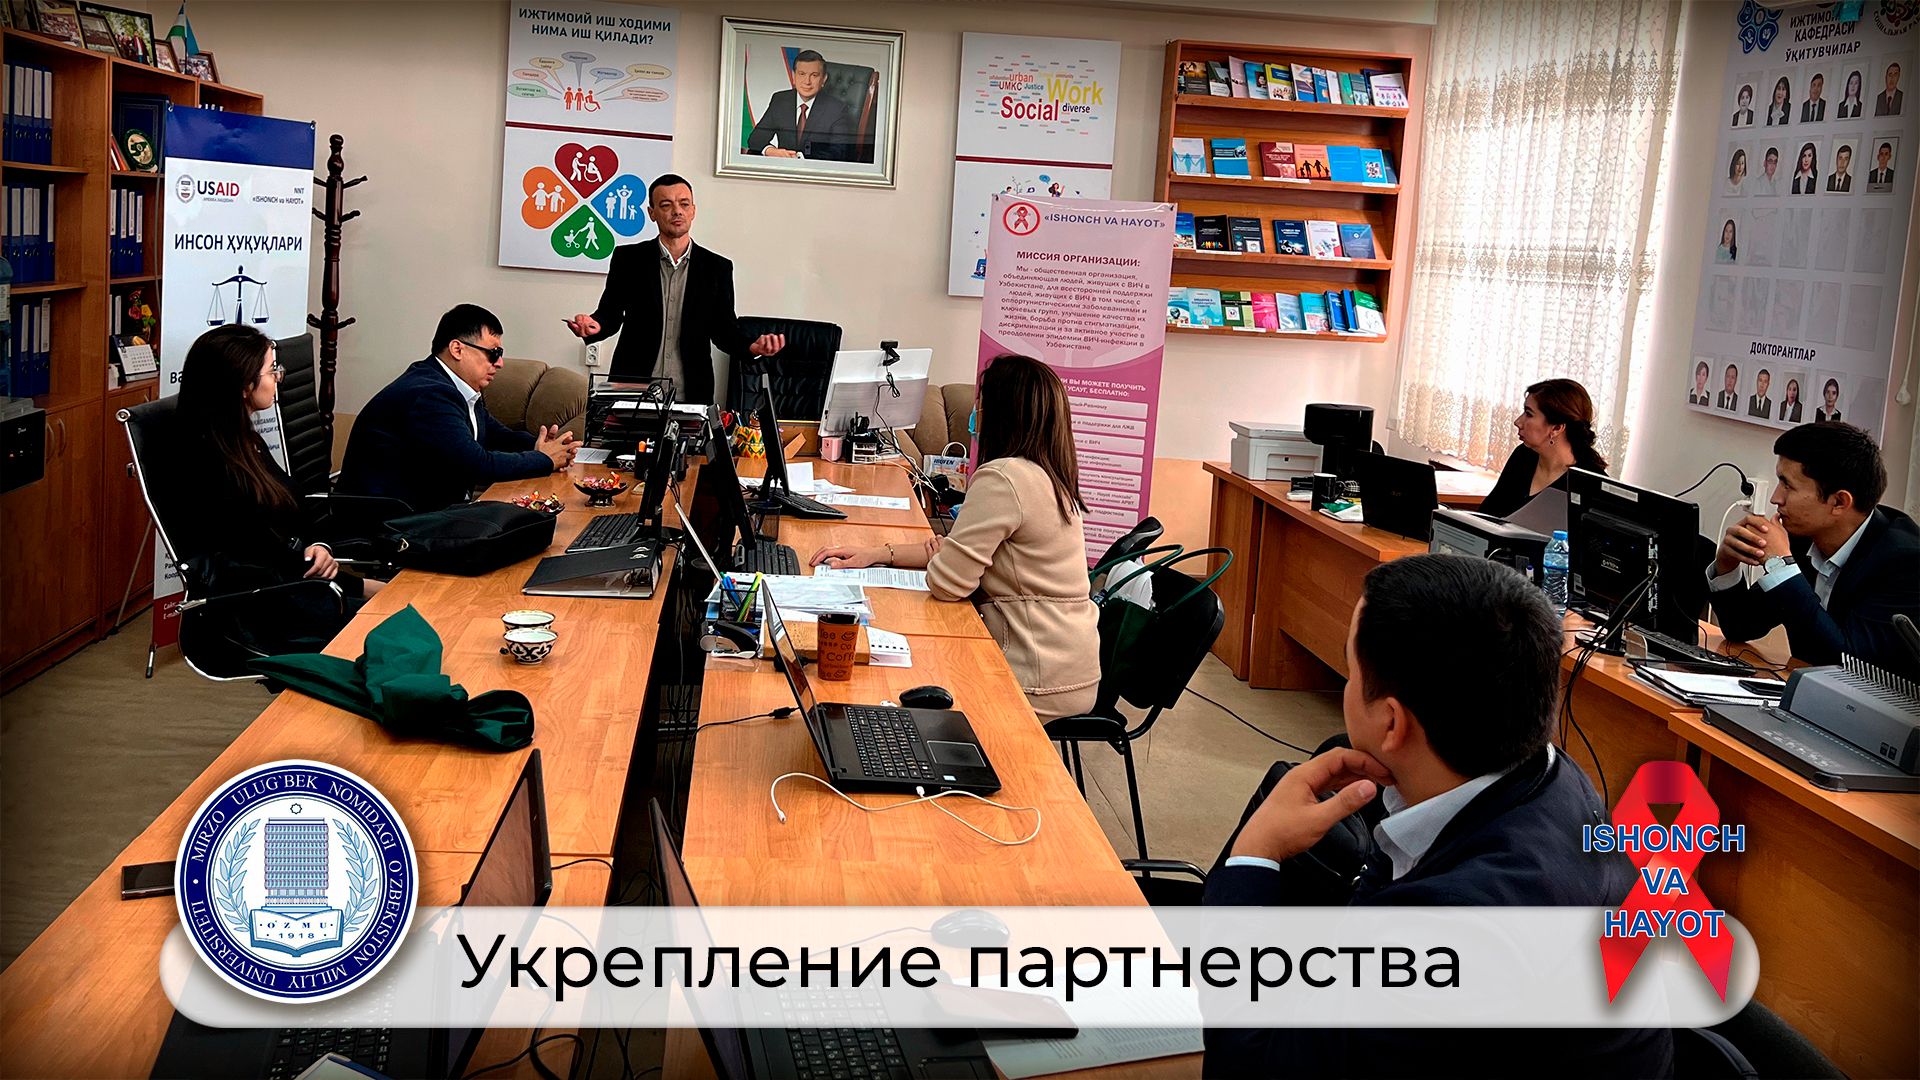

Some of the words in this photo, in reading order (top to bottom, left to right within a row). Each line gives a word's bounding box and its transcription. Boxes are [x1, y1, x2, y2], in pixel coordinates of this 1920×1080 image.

[519, 8, 592, 25] ИЖТИМОИЙ
[596, 15, 615, 27] ИШ
[618, 17, 671, 32] ХОДИМИ
[531, 24, 567, 37] НИМА
[571, 28, 591, 40] ИШ
[595, 31, 654, 45] ҚИЛАДИ?
[1794, 21, 1856, 42] КАФЕДРАСИ
[1785, 41, 1861, 62] ЎҚИТУВЧИЛАР
[1009, 72, 1034, 83] urban
[999, 80, 1022, 91] UMKC
[1024, 82, 1044, 91] Justice
[1046, 78, 1103, 105] Work
[1000, 95, 1060, 121] Social
[1062, 102, 1091, 113] diverse
[197, 180, 240, 197] USAID
[1044, 213, 1101, 224] «ISHONCH
[1104, 216, 1118, 226] VA
[1121, 218, 1166, 228] HAYOT»
[174, 233, 223, 250] ИНСОН
[226, 235, 303, 254] ҲУҚУҚЛАРИ
[1016, 251, 1060, 262] МИССИЯ
[1062, 254, 1141, 267] ОРГАНИЗАЦИИ:
[1034, 267, 1087, 277] общественная
[1003, 273, 1058, 282] объединяющая
[1127, 281, 1143, 289] ВИЧ
[1035, 292, 1067, 300] живущих
[1060, 286, 1111, 295] всесторонней
[1112, 290, 1153, 298] поддержки
[1061, 311, 1101, 319] улучшение
[1082, 304, 1140, 313] заболеваниями
[1030, 314, 1056, 323] борьба
[998, 330, 1045, 339] преодолении
[1046, 333, 1082, 342] эпидемии
[1750, 341, 1816, 361] ДОКТОРАНТЛАР
[1081, 380, 1110, 388] МОЖЕТЕ
[1111, 382, 1146, 391] ПОЛУЧИТЬ
